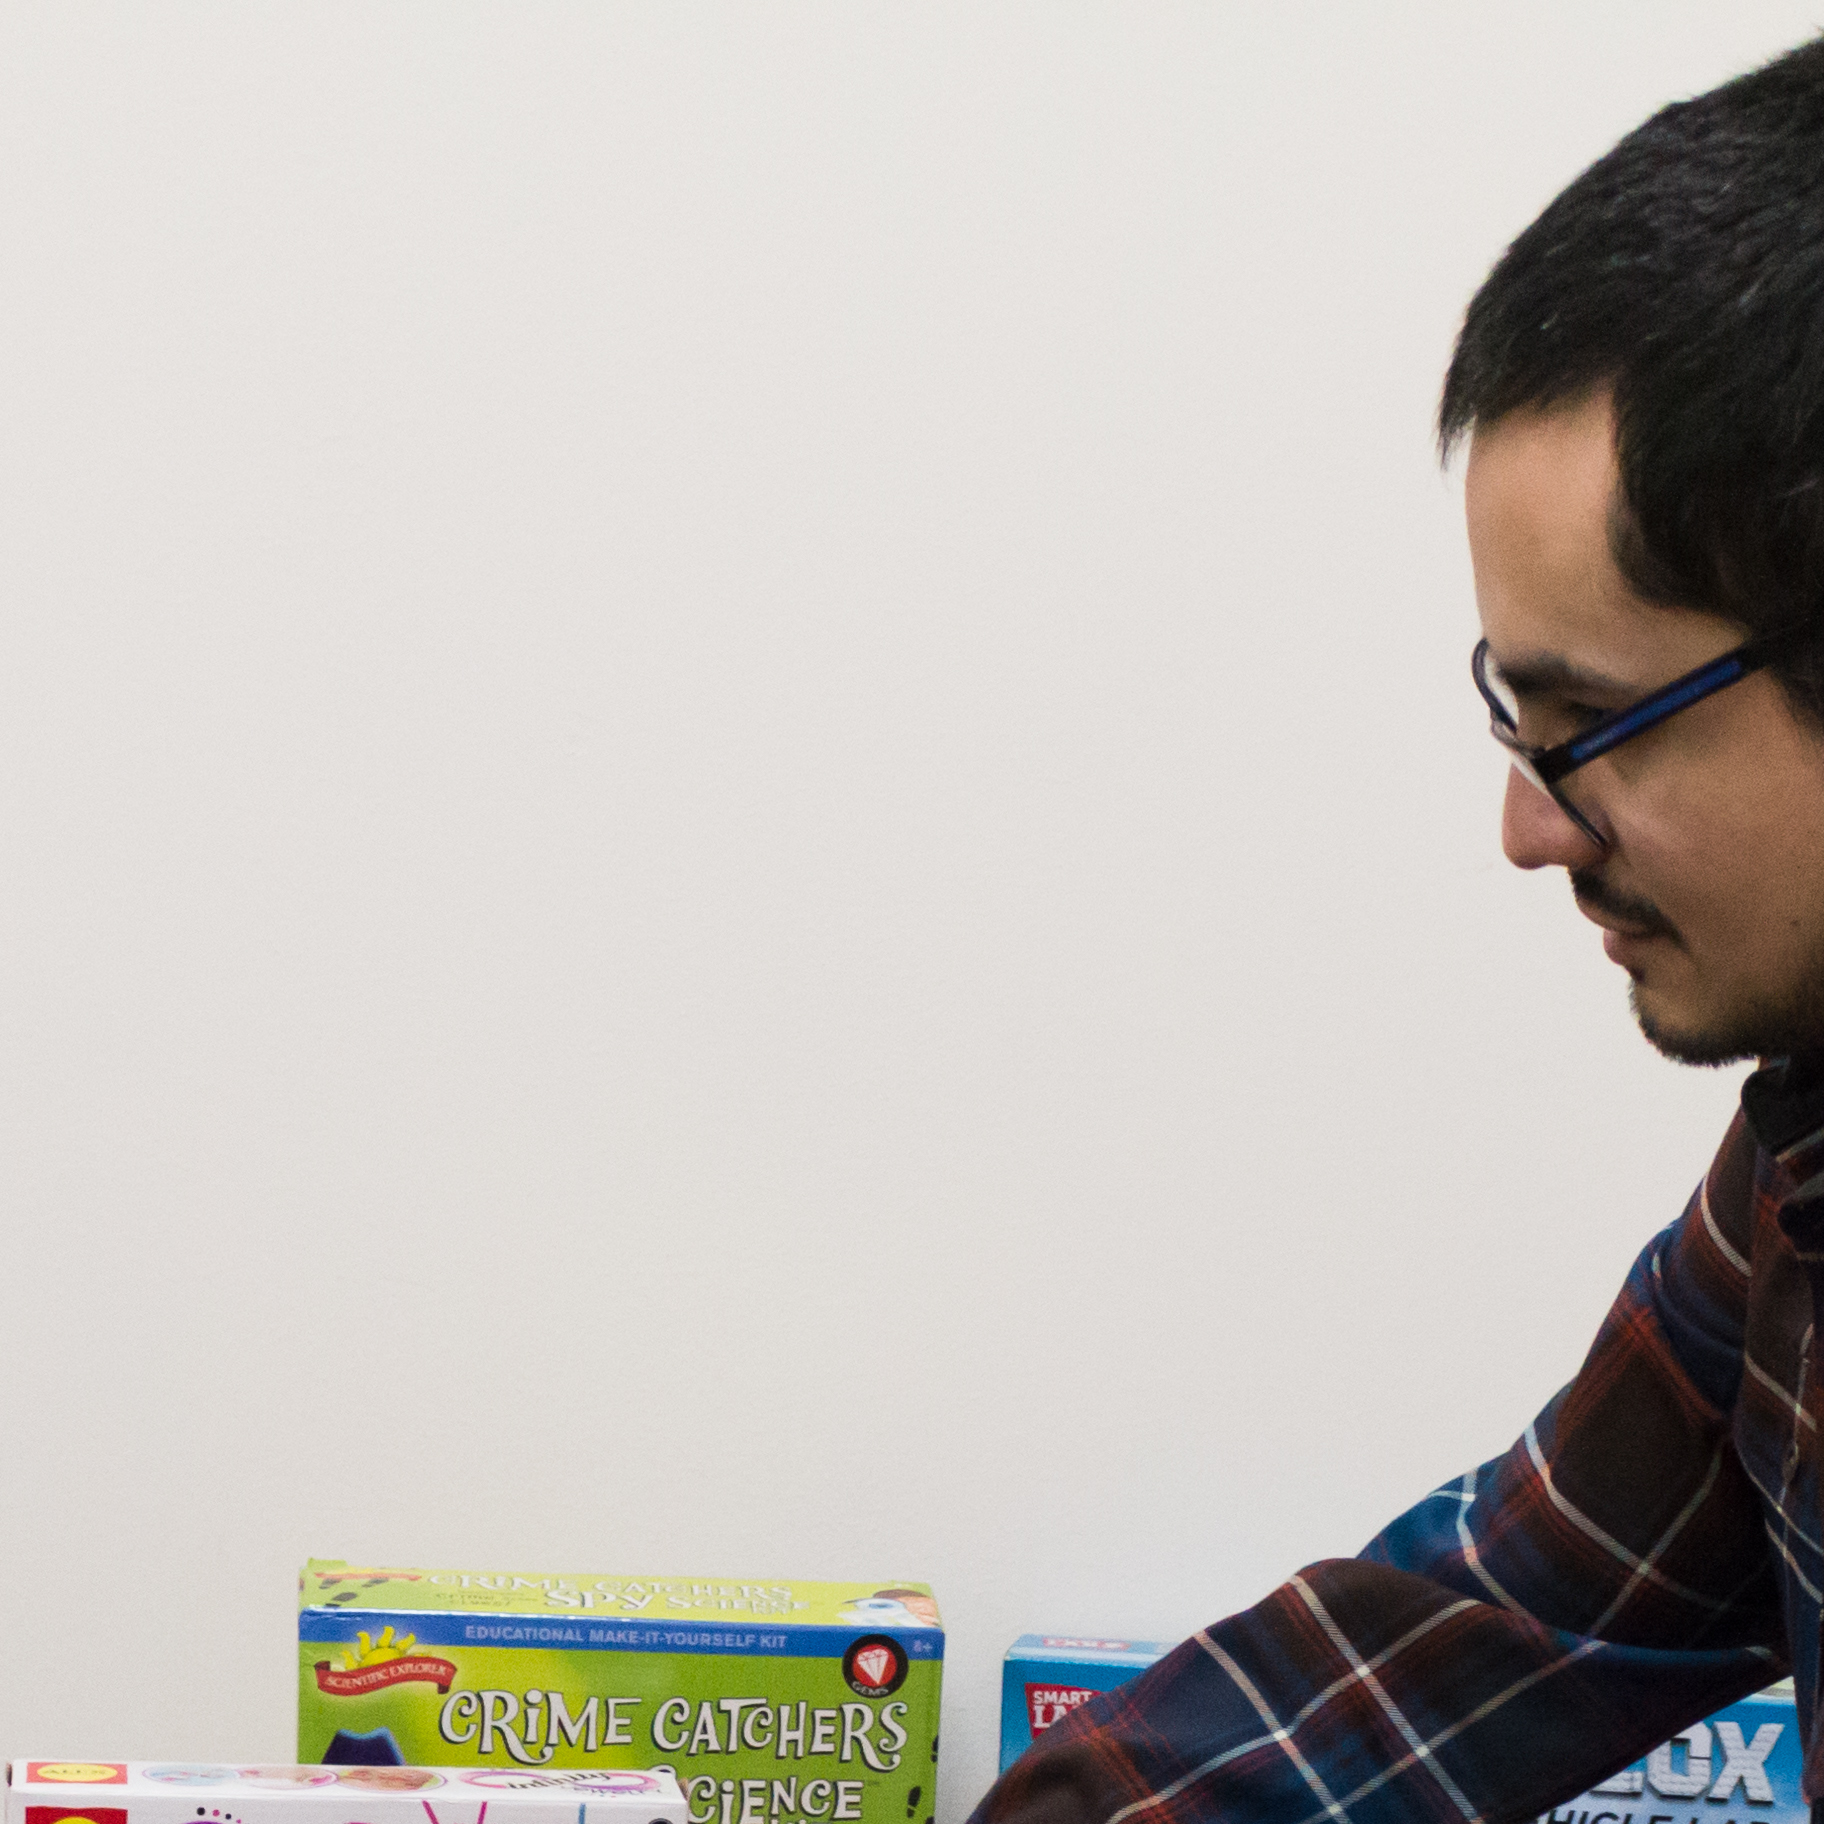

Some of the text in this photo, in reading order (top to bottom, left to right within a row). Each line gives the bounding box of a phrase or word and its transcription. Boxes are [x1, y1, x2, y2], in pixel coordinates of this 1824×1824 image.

[465, 1625, 788, 1648] EDUCATIONAL MAKE-IT-YOURSELF KIT
[325, 1667, 389, 1688] SCIENTIFIC
[1033, 1690, 1093, 1705] SMART
[1033, 1705, 1068, 1728] LA
[651, 1696, 907, 1772] CATCHERS
